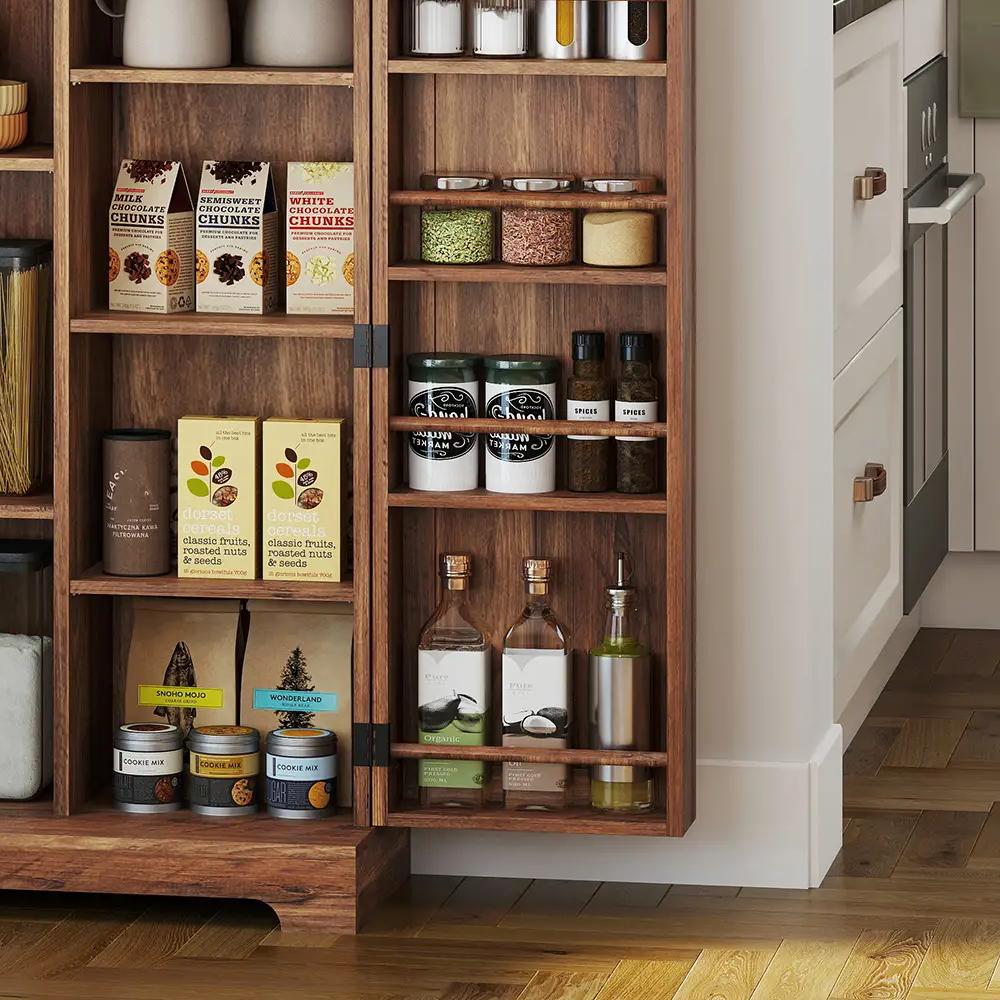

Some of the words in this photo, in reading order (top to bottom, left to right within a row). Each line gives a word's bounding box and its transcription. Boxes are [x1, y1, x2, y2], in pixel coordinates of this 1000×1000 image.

[114, 194, 144, 202] MILK
[200, 197, 262, 205] SEMISWEET
[112, 204, 166, 213] CHOCOLATE
[111, 213, 164, 224] CHUNKS
[198, 215, 260, 225] CHUNKS
[289, 216, 354, 226] CHUNKS
[182, 506, 233, 520] dorset
[267, 508, 319, 523] dorset
[182, 522, 240, 534] cereals
[267, 525, 325, 537] cereals
[183, 536, 217, 544] classic
[220, 537, 250, 547] fruits,
[268, 539, 302, 547] classic
[305, 540, 336, 549] fruits,
[183, 547, 221, 555] roasted
[183, 556, 192, 564] &
[194, 557, 222, 565] seeds
[268, 559, 277, 567] &
[279, 559, 307, 567] seeds
[270, 694, 322, 702] WONDERLAND
[424, 735, 460, 743] Organic
